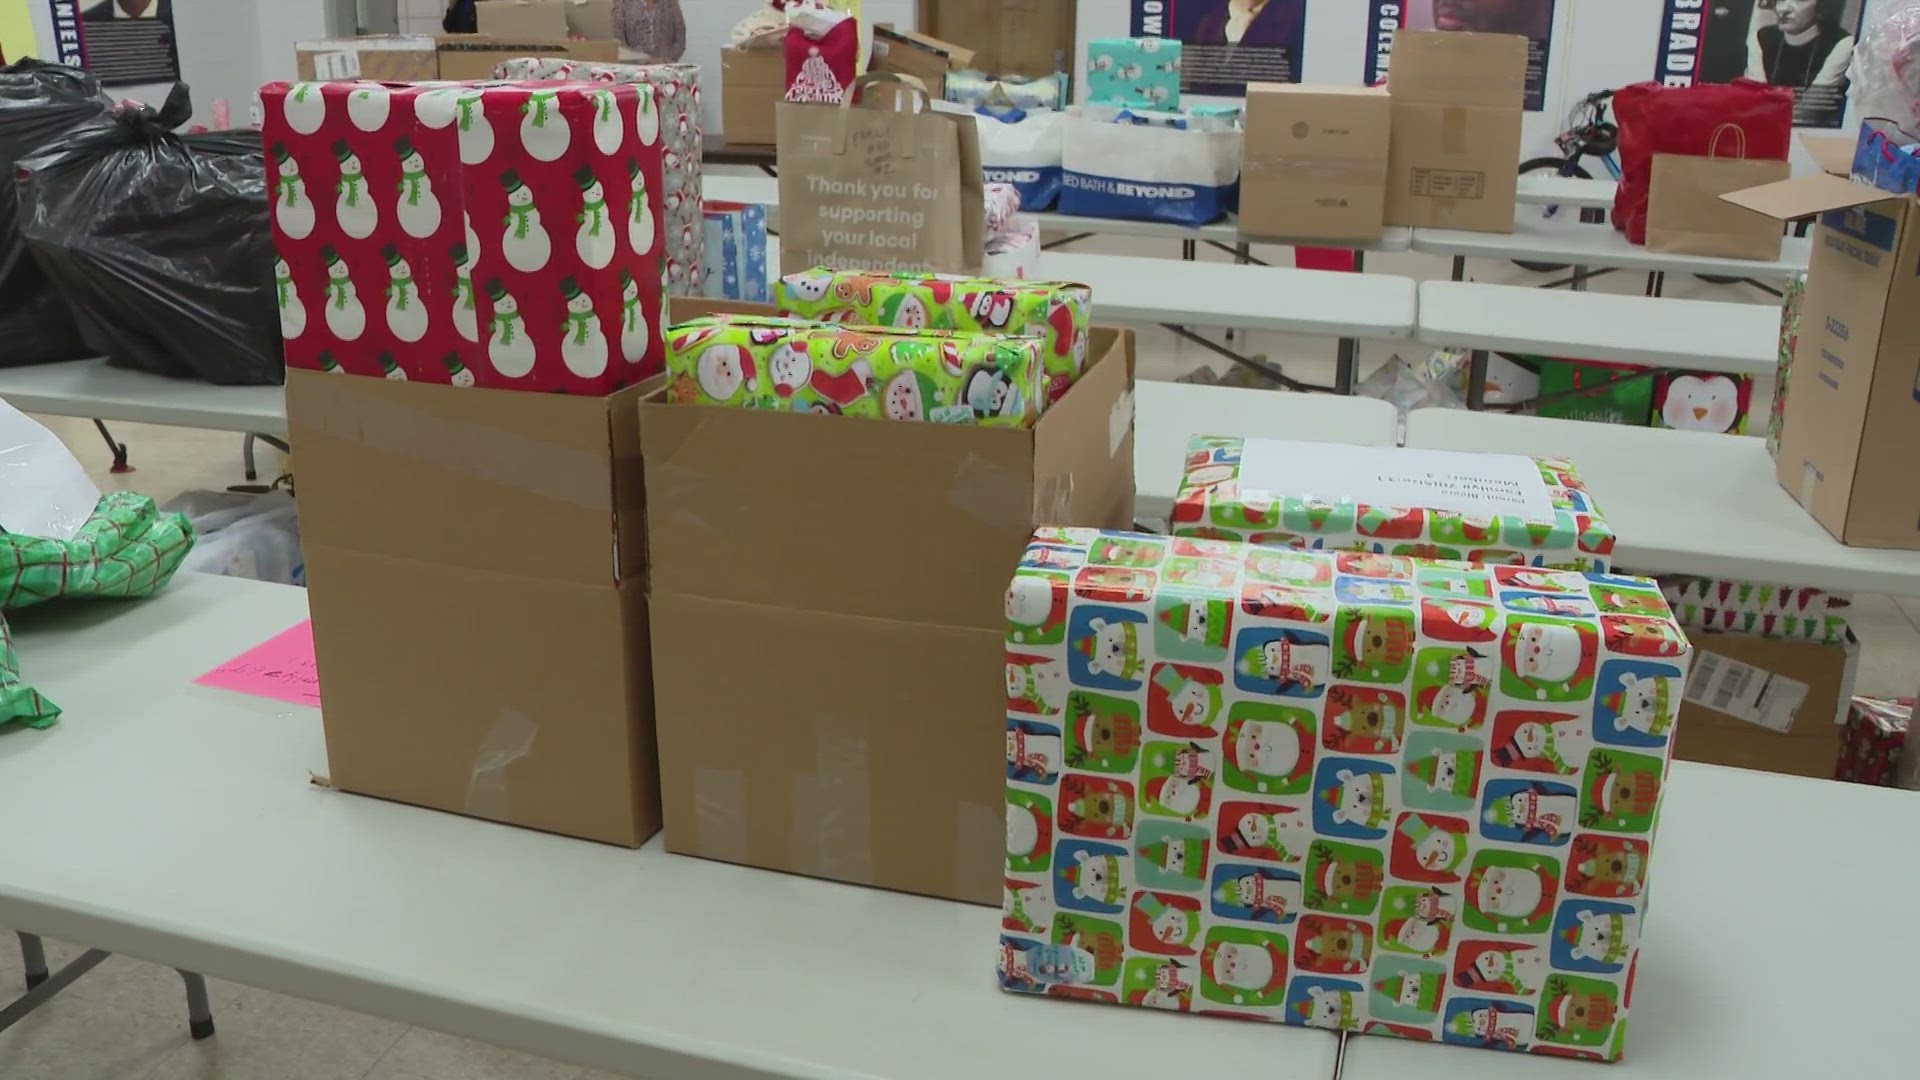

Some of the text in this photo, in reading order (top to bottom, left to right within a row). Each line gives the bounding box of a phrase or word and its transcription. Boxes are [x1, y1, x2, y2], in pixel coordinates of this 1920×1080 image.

[806, 175, 867, 197] Thank
[870, 183, 907, 201] you
[1080, 177, 1106, 192] BATH
[1107, 181, 1116, 194] &
[1116, 182, 1196, 200] BEYOND
[818, 203, 924, 229] supporting
[822, 229, 917, 249] your local
